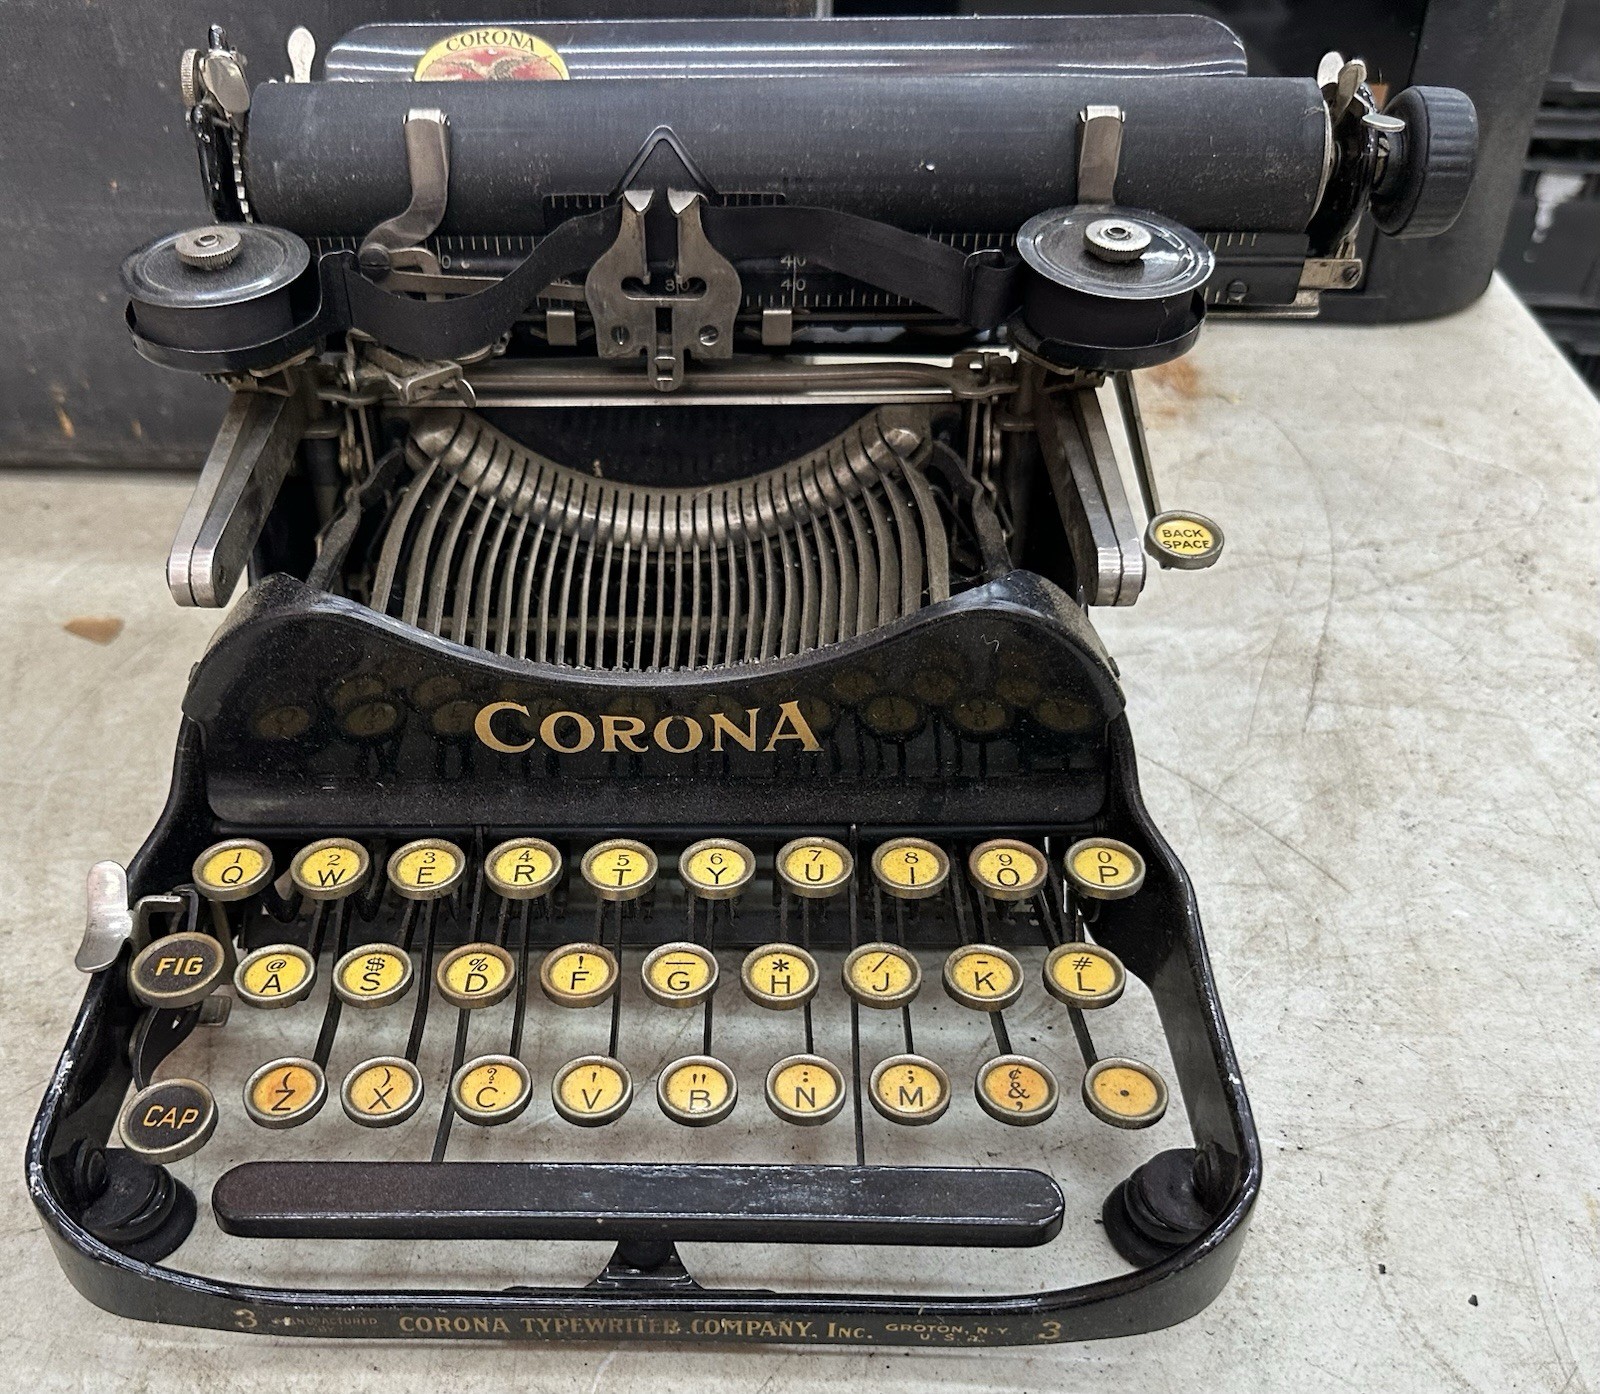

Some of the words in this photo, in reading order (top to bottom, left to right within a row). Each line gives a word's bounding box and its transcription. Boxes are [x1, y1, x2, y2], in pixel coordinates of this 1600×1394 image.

[446, 31, 535, 52] CORONA
[781, 279, 806, 291] 40
[1162, 529, 1203, 538] BACK
[1163, 540, 1210, 549] SPACE
[474, 700, 825, 753] CORONA
[233, 852, 242, 864] 1
[327, 854, 341, 866] 2
[423, 852, 436, 864] 3
[518, 851, 533, 863] 4
[617, 854, 630, 866] 5
[710, 853, 723, 865] 6
[808, 850, 822, 862] 7
[904, 852, 919, 864] 8
[997, 854, 1013, 867] 9
[221, 866, 244, 885] Q
[318, 868, 346, 887] W
[416, 866, 436, 885] E
[513, 865, 536, 883] R
[612, 868, 632, 886] T
[706, 867, 728, 885] Y
[805, 864, 824, 882] U
[910, 867, 915, 885] I
[997, 868, 1020, 887] O
[1099, 866, 1119, 884] P
[155, 957, 204, 977] FIG
[266, 959, 287, 973] @
[366, 957, 385, 972] $
[469, 957, 488, 973] %
[578, 956, 584, 969] !
[872, 954, 889, 973] /
[1072, 956, 1093, 970] #
[259, 974, 282, 993] A
[360, 972, 381, 992] S
[464, 973, 488, 993] D
[570, 971, 590, 990] F
[667, 971, 691, 991] G
[771, 974, 791, 995] H
[872, 973, 890, 992] J
[975, 971, 996, 991] K
[1077, 971, 1097, 992] L
[282, 1072, 292, 1090] (
[381, 1068, 391, 1088] )
[487, 1067, 498, 1084] ?
[802, 1071, 809, 1083] :
[907, 1070, 914, 1083] ;
[271, 1089, 296, 1111] Z
[368, 1087, 394, 1110] X
[475, 1086, 499, 1108] C
[581, 1089, 603, 1110] V
[689, 1089, 711, 1111] B
[795, 1086, 816, 1108] N
[899, 1086, 924, 1108] M
[1008, 1082, 1030, 1100] &
[142, 1105, 199, 1130] CAP
[233, 1308, 258, 1329] 3
[400, 1316, 510, 1333] CORONA
[520, 1316, 679, 1335] TYPEWRITER
[885, 1323, 969, 1335] GROTON,
[1038, 1321, 1062, 1340] 3
